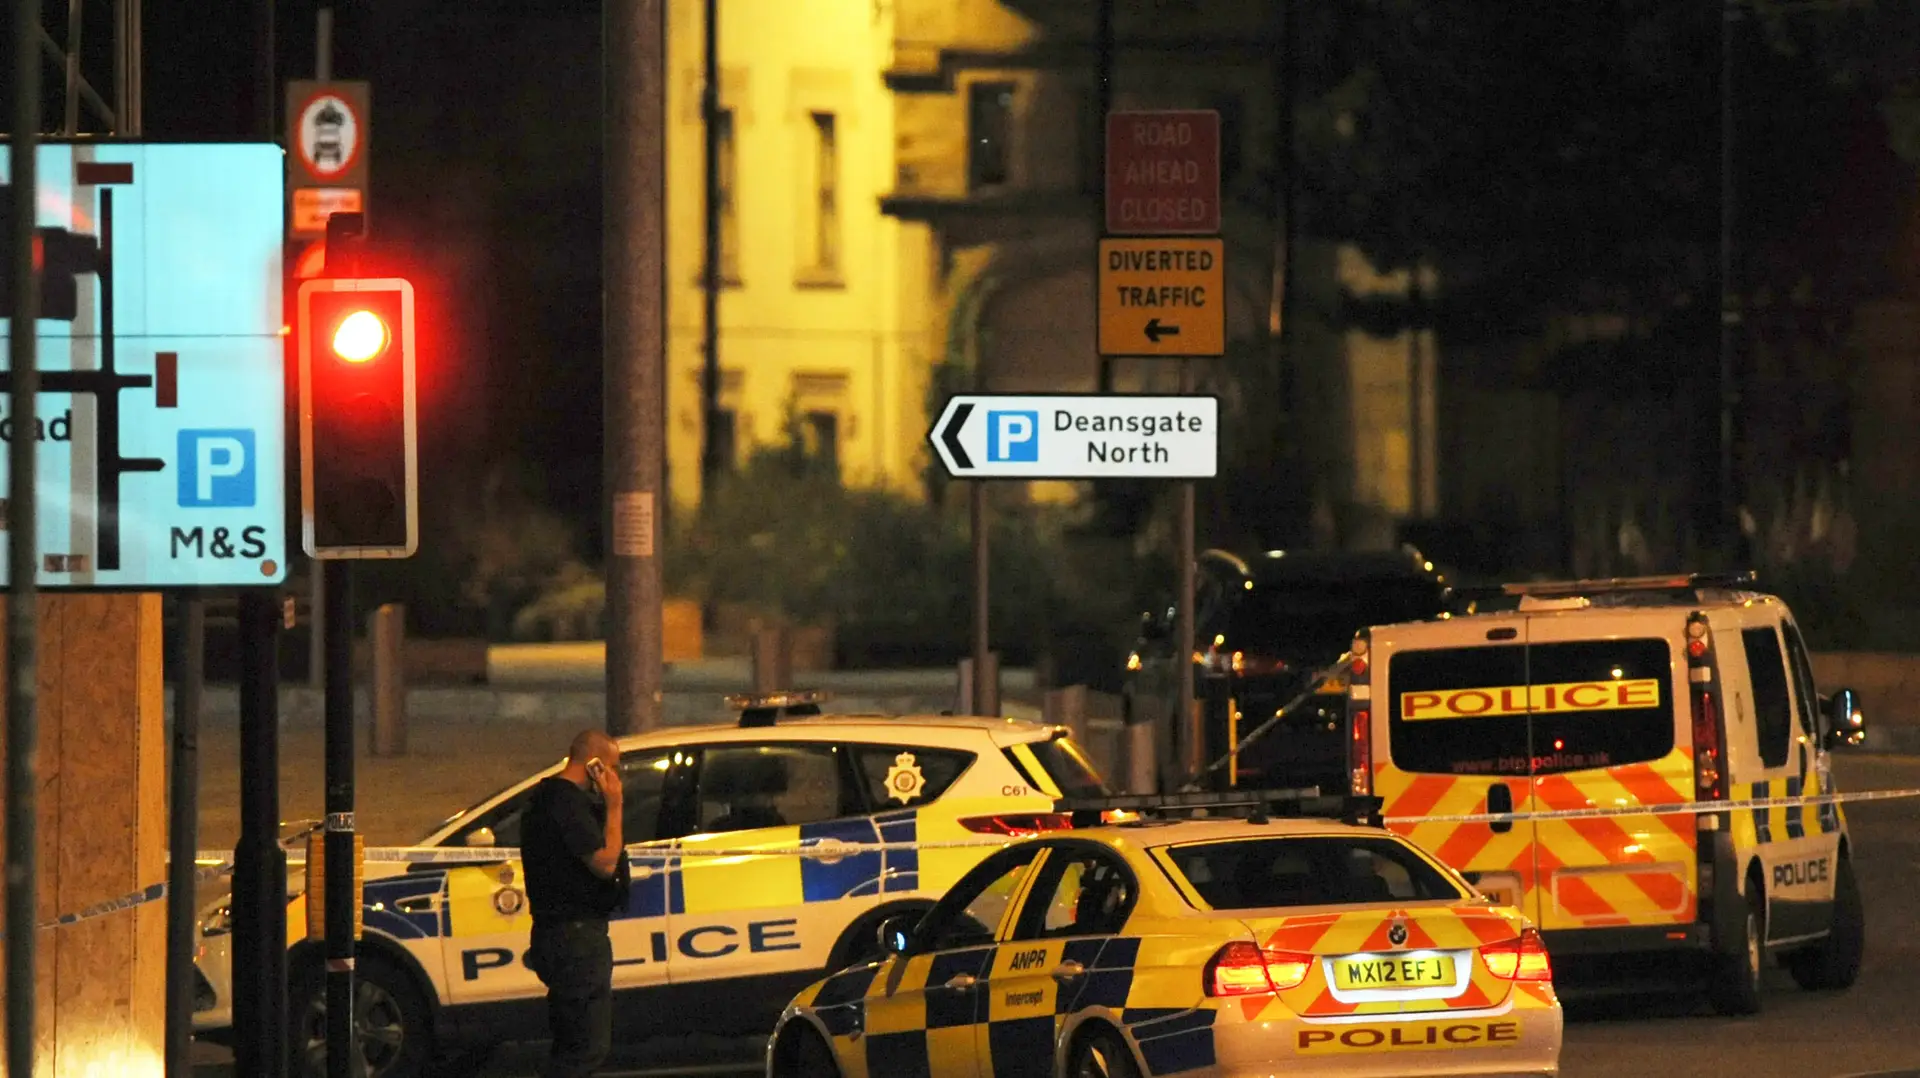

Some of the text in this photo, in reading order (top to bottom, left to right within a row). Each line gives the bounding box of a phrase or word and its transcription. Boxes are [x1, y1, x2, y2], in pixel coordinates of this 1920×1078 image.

[1133, 121, 1192, 146] ROAD
[1125, 160, 1198, 185] AHEAD
[1119, 197, 1205, 222] CLOSED
[1109, 250, 1213, 272] DIVERTED
[1117, 285, 1206, 308] TRAFFIC
[1054, 410, 1202, 436] Deansgate
[998, 414, 1033, 459] P
[1087, 441, 1169, 463] North
[196, 436, 245, 500] P
[170, 525, 267, 559] M&S
[1404, 681, 1656, 718] POLICE
[1001, 785, 1028, 797] C61
[1773, 858, 1828, 888] POLICE
[1008, 948, 1048, 972] ANPR
[1347, 959, 1443, 984] MX12 EFJ
[1005, 988, 1044, 1008] Intercept
[1298, 1022, 1518, 1049] POLICE
